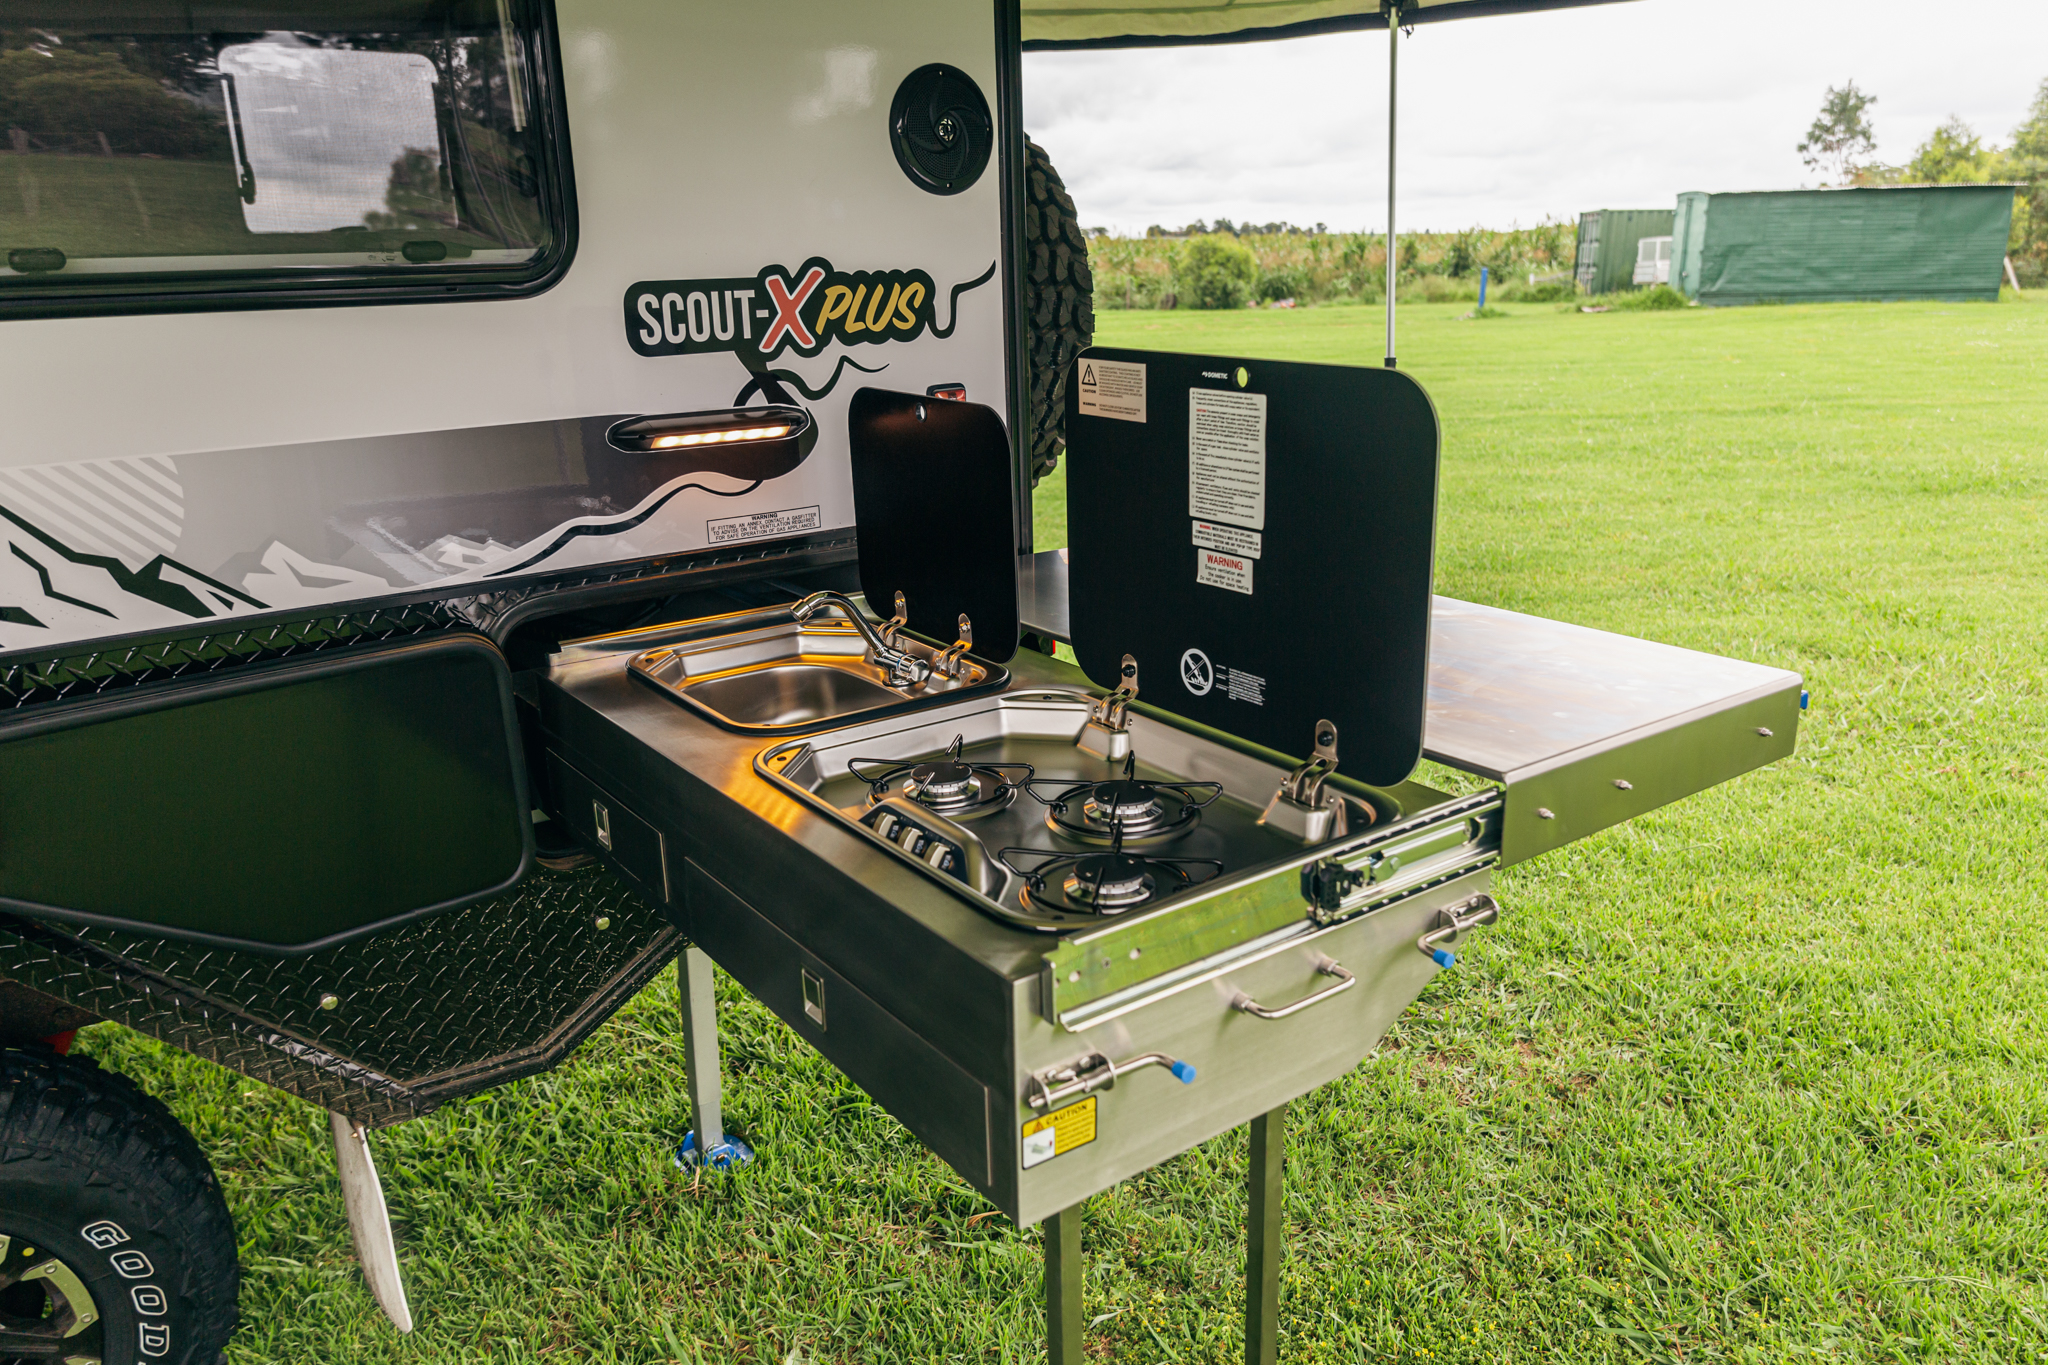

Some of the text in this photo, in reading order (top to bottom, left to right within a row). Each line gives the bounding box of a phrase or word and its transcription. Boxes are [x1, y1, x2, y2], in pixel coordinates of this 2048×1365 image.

[815, 282, 925, 336] PLUS
[752, 513, 778, 521] WARNING
[760, 521, 790, 530] VENTILATION
[792, 517, 815, 525] REQUIRED
[764, 516, 784, 524] CONTACT
[740, 528, 768, 537] OPERATION
[787, 522, 816, 530] APPLIANCES
[1207, 554, 1243, 571] WARNING
[1218, 568, 1236, 576] ventilation
[1046, 1103, 1088, 1126] CAUTION
[81, 1220, 170, 1365] GOOD
